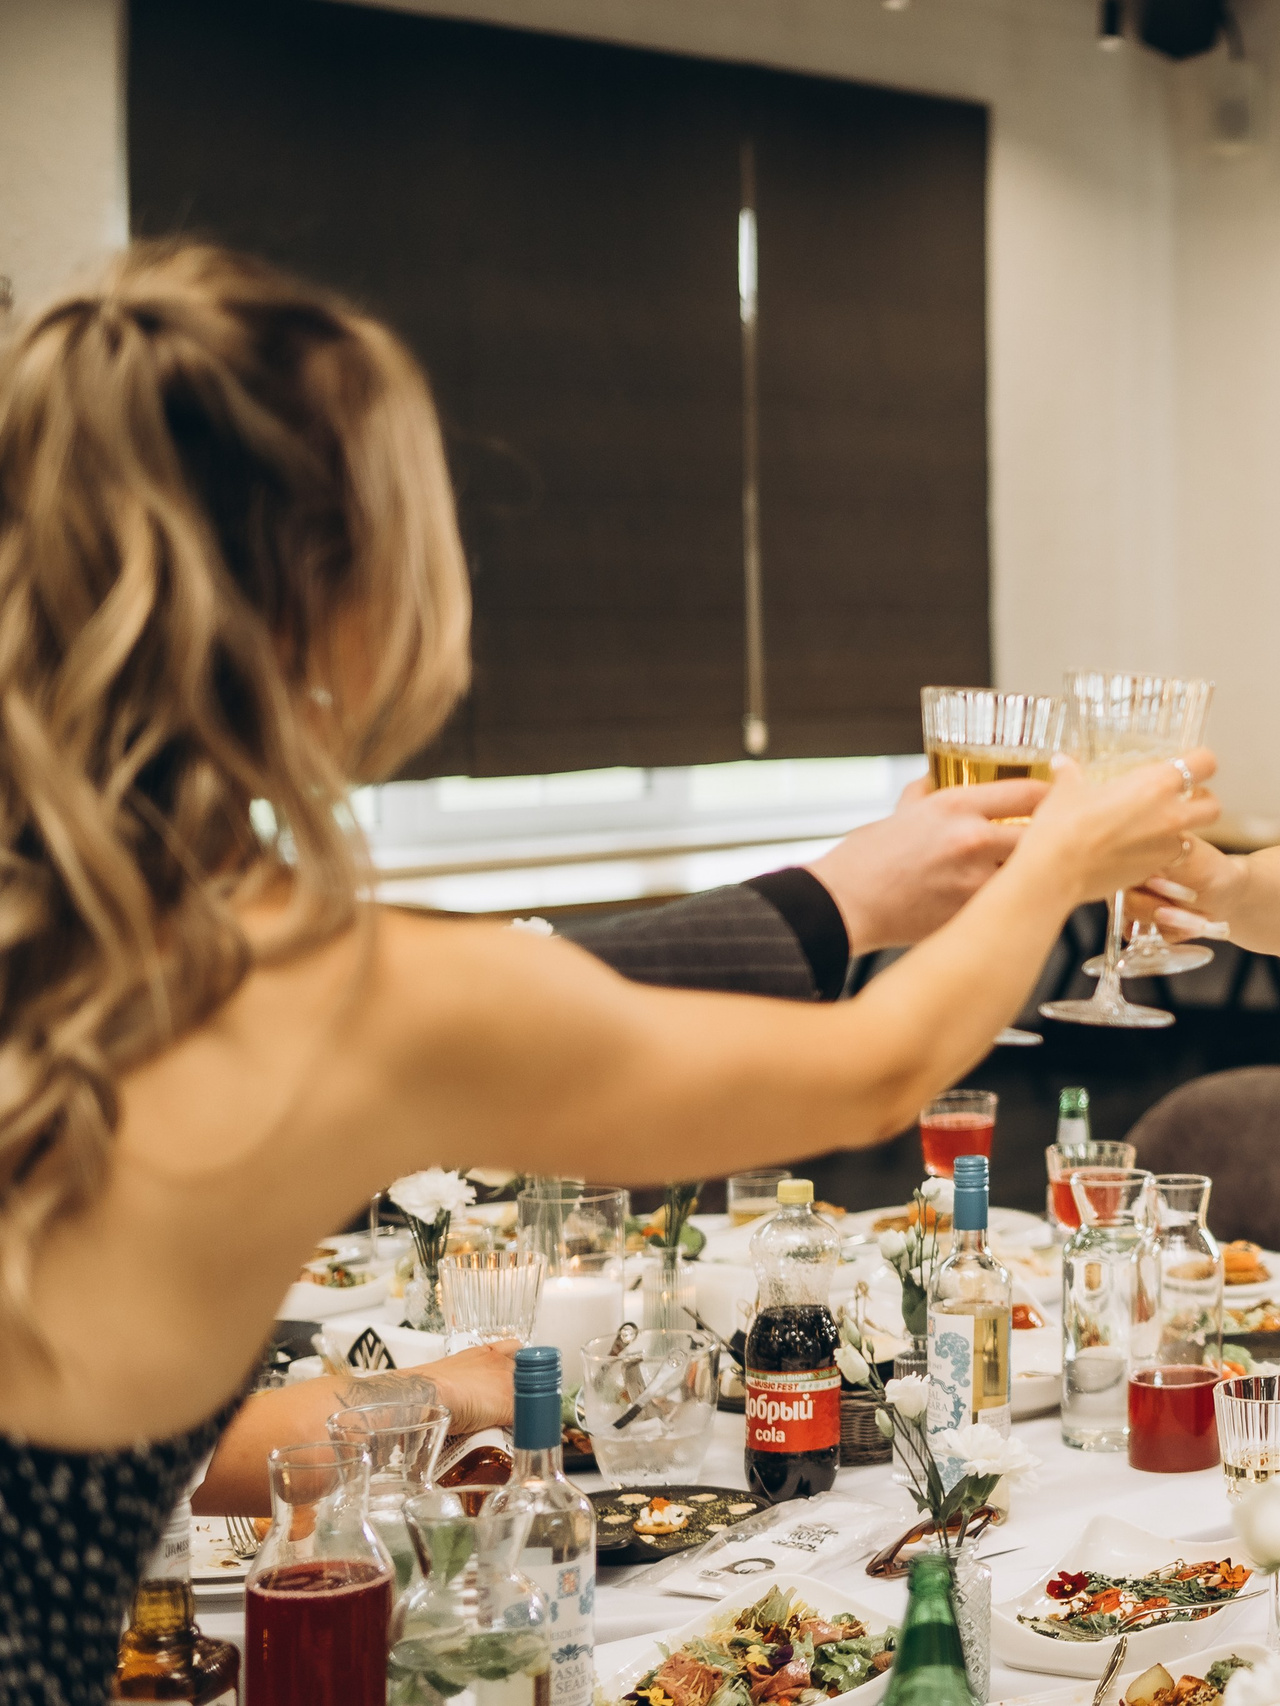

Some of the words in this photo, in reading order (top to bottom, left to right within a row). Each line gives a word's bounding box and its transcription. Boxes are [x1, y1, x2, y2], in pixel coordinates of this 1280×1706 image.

[754, 1379, 776, 1390] MUSIC
[776, 1383, 799, 1391] FEST
[755, 1426, 786, 1443] cola
